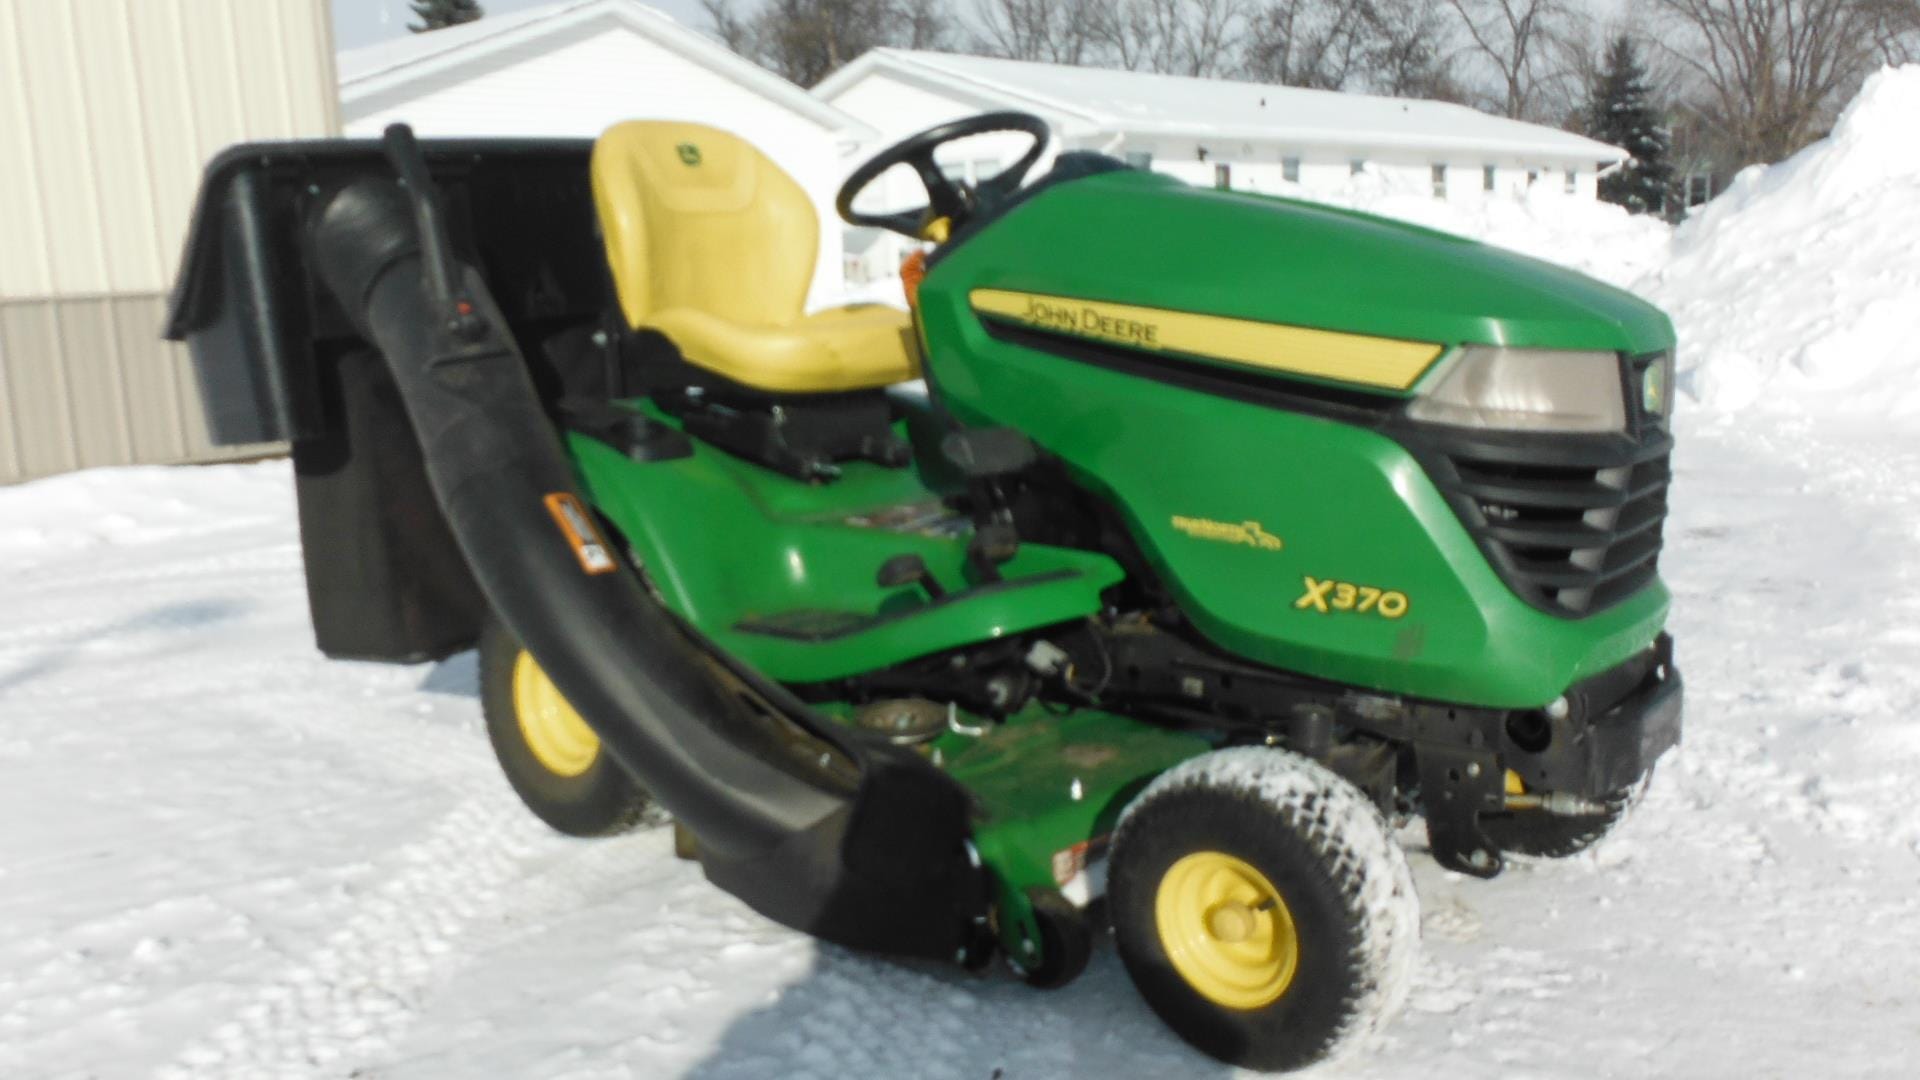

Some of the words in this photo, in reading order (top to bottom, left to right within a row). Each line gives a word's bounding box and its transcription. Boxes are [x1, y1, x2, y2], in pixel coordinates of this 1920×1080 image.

[1022, 296, 1078, 327] JOHN
[1082, 308, 1158, 342] DEERE
[1295, 576, 1409, 619] X370
